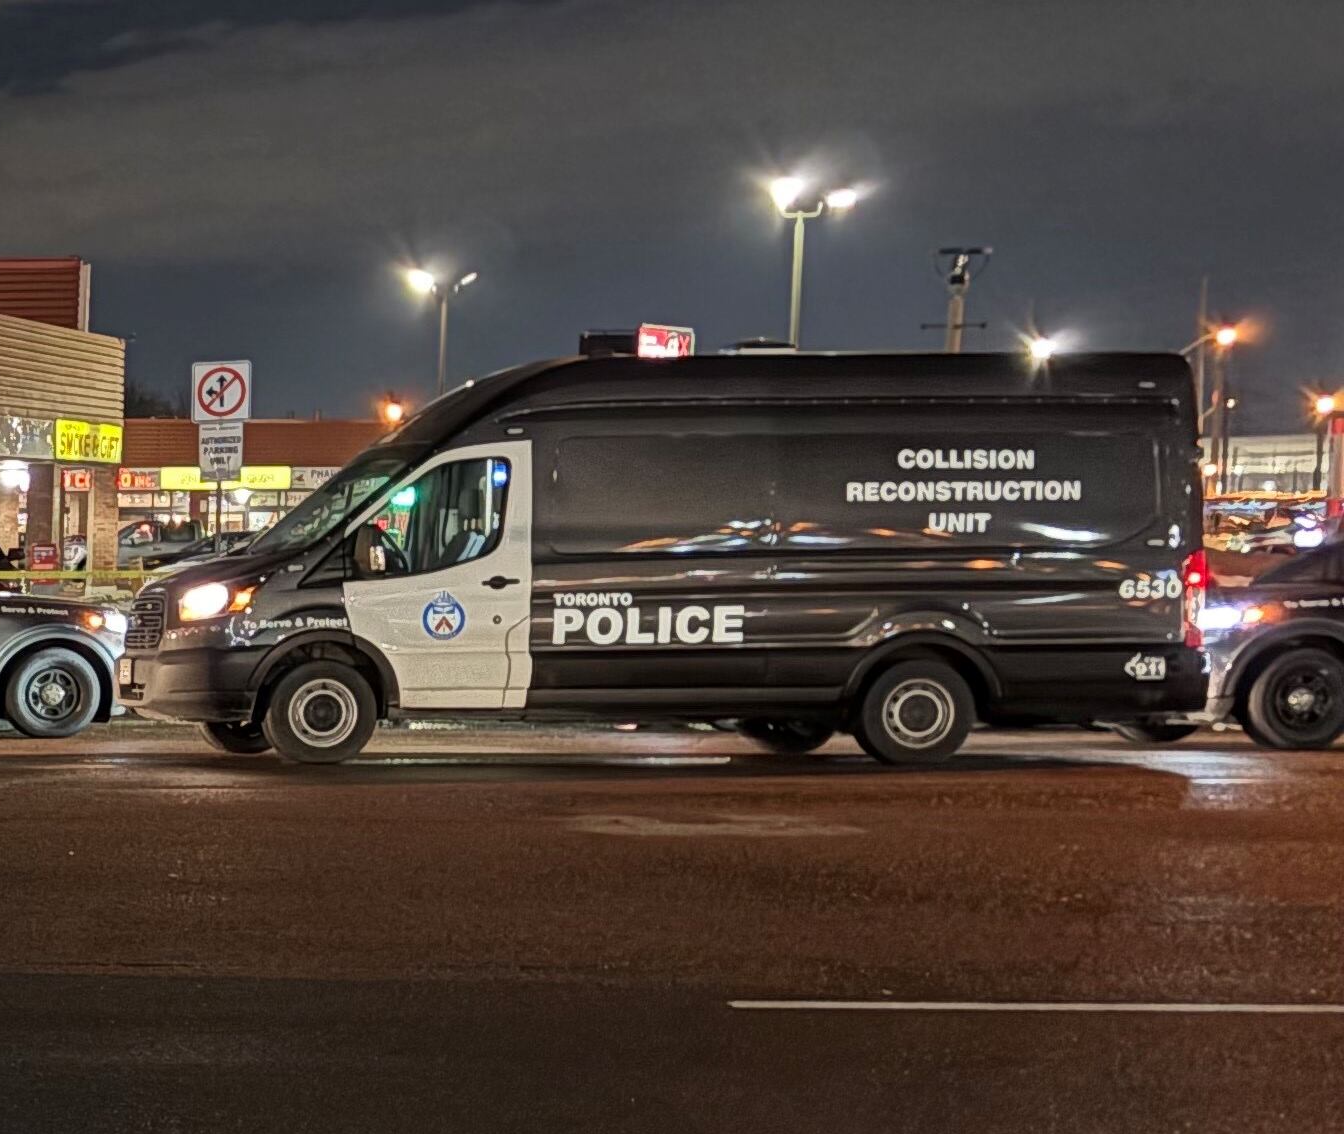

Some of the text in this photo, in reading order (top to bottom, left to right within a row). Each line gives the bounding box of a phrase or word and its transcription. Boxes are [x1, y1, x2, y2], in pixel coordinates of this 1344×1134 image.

[897, 448, 1035, 470] COLLISION
[846, 480, 1081, 502] RECONSTRUCTION
[928, 512, 992, 534] UNIT
[553, 592, 633, 606] TORONTO
[1119, 579, 1183, 599] 6530
[242, 616, 347, 630] To Serve & Protect
[552, 605, 744, 645] POLICE
